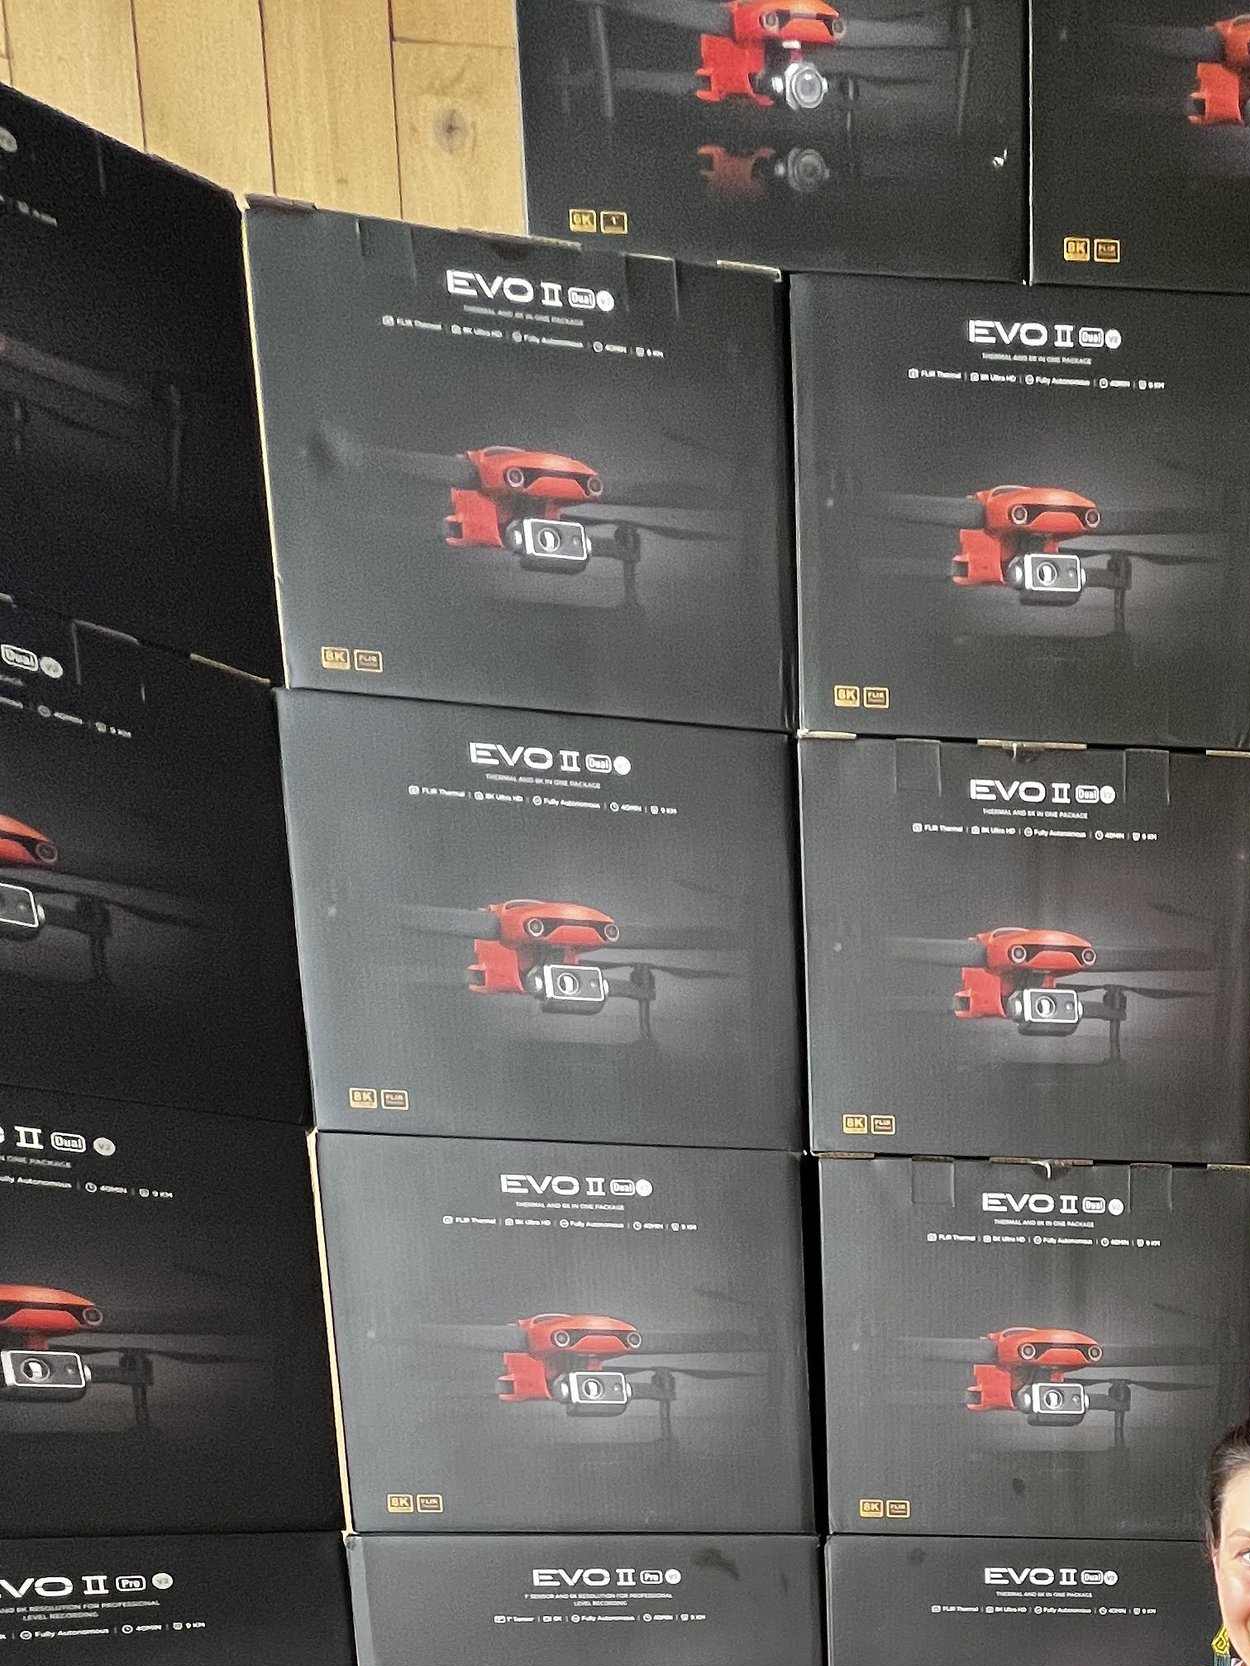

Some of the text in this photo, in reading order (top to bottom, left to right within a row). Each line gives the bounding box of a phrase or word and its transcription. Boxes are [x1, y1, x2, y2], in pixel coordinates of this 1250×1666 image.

[447, 270, 533, 303] EVO
[967, 320, 1047, 346] EVO
[470, 742, 553, 769] EVO
[586, 755, 612, 773] Dual
[970, 779, 1045, 802] EVO
[54, 1136, 83, 1150] Dual
[501, 1175, 579, 1195] EVO
[982, 1193, 1054, 1213] EVO
[533, 1569, 610, 1586] EVO
[985, 1568, 1054, 1585] EVO
[0, 1577, 73, 1598] VO
[120, 1578, 141, 1589] Pro
[29, 1604, 81, 1612] RESOLUTION
[101, 1600, 160, 1608] PROFESSIONAL
[49, 1612, 99, 1620] RECORDING
[34, 1631, 56, 1639] Fully
[57, 1628, 109, 1636] Autonomous
